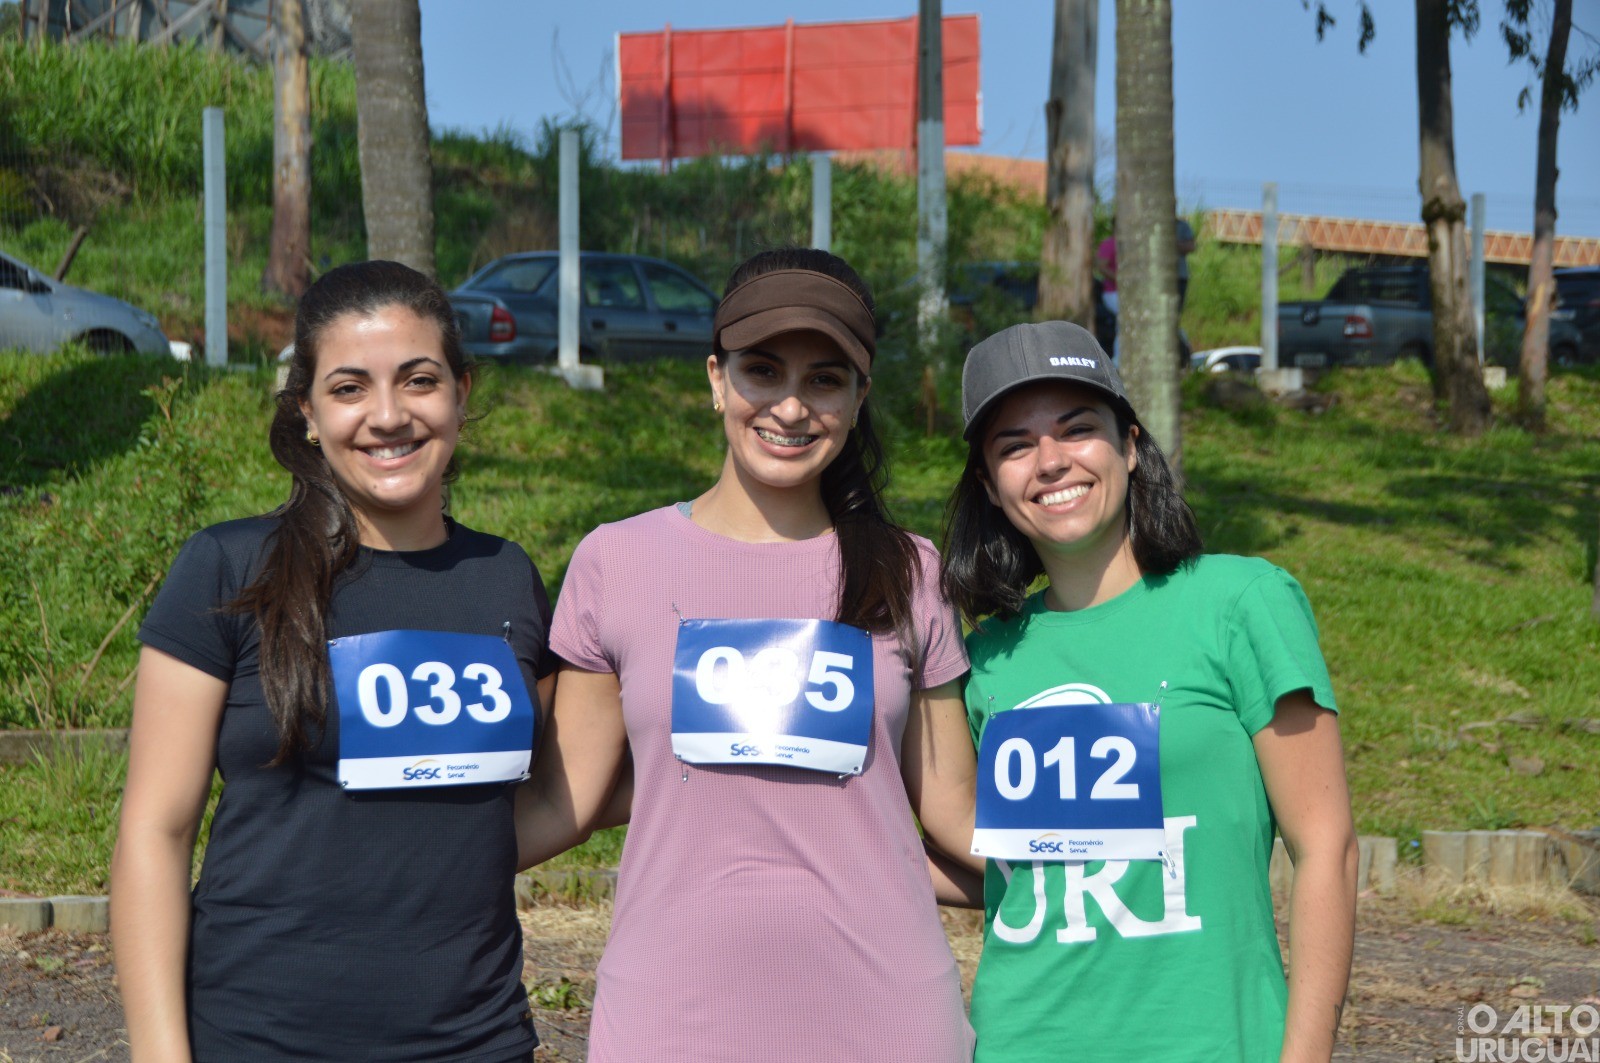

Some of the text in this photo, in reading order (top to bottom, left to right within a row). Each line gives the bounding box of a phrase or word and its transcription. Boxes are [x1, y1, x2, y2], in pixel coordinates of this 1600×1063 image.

[1049, 357, 1096, 369] OAKLEY
[357, 661, 512, 728] 033
[730, 743, 764, 756] Ses
[403, 767, 441, 780] Sesc
[994, 735, 1140, 801] 012
[1029, 839, 1064, 853] Sesc
